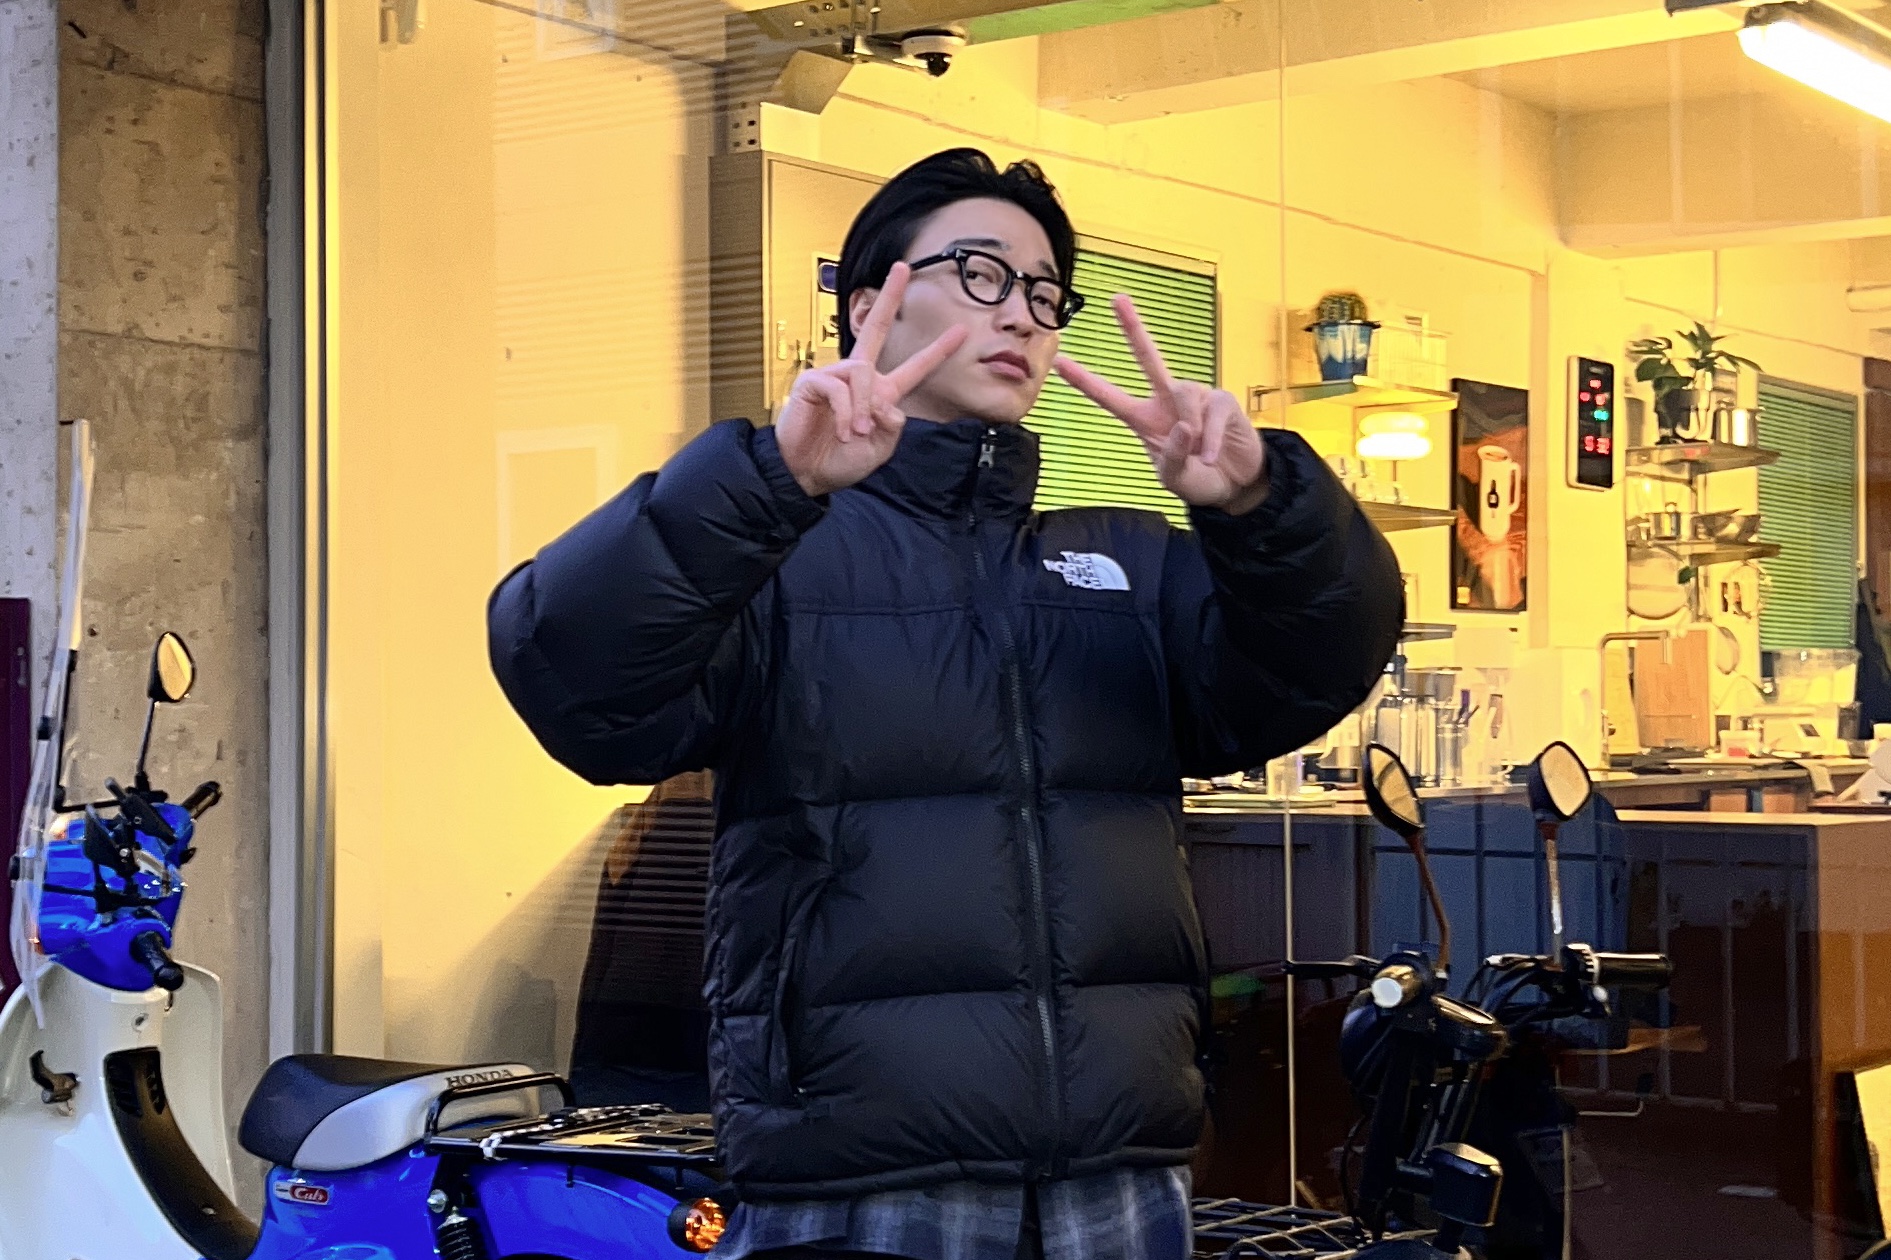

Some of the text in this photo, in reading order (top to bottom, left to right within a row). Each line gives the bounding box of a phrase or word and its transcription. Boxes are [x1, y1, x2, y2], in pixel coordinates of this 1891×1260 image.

[1060, 551, 1091, 564] THE
[1042, 559, 1094, 578] NORTH
[1063, 573, 1102, 591] FACE
[444, 1069, 514, 1089] HONDA
[294, 1187, 325, 1201] Cub
